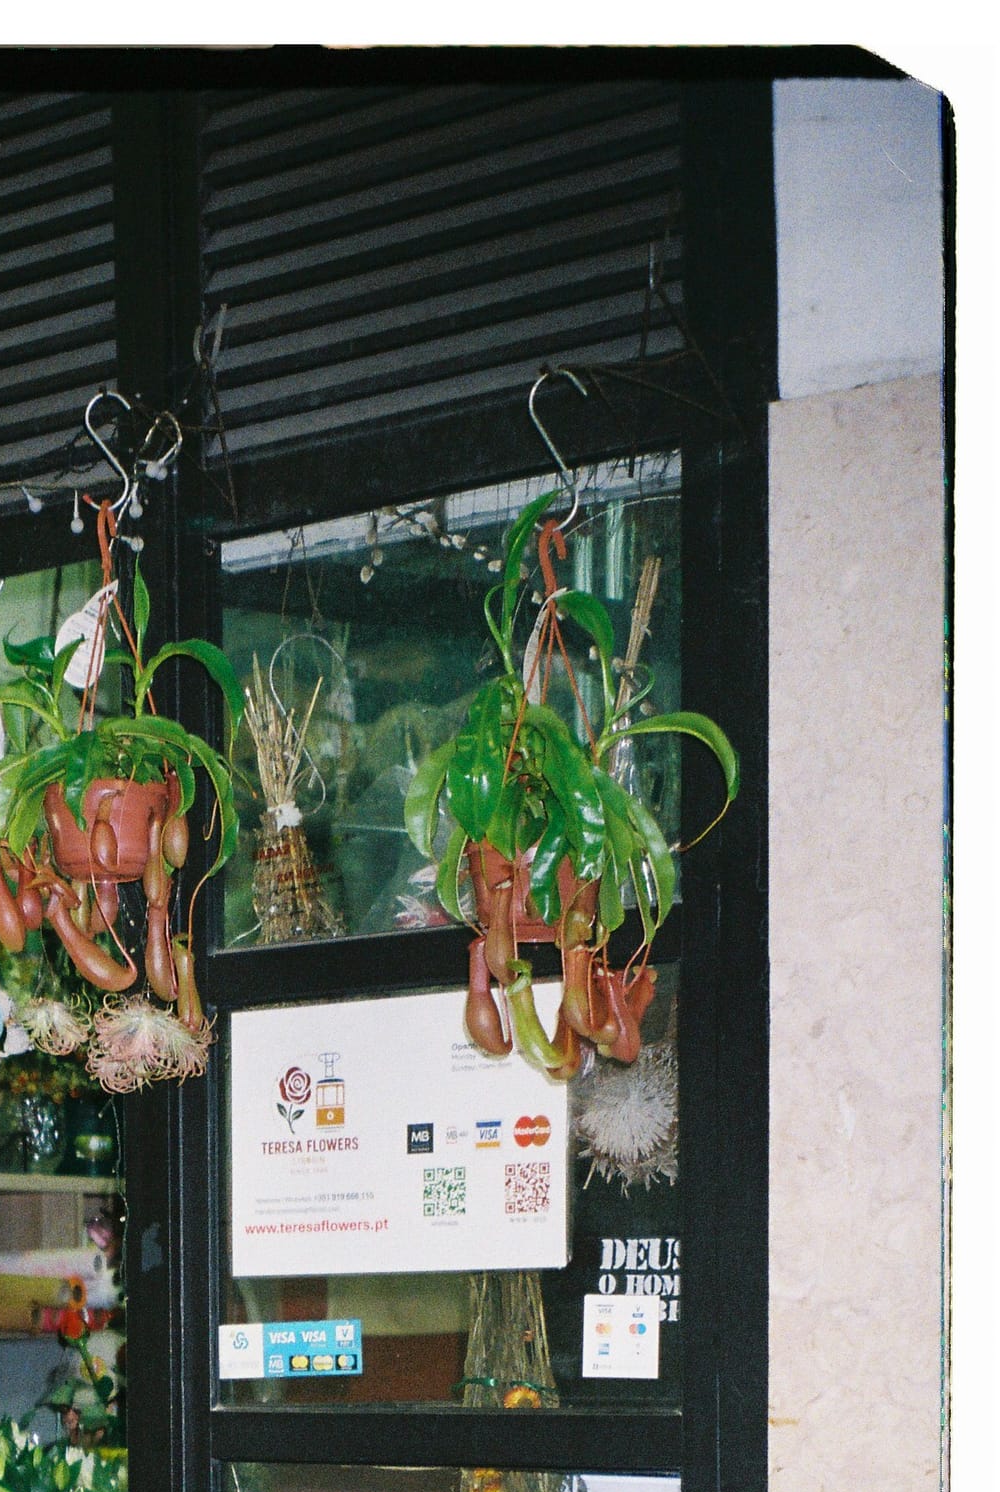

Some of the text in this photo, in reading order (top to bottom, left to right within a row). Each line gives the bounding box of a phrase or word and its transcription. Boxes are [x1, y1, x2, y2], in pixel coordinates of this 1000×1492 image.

[411, 1130, 430, 1143] MB
[479, 1128, 498, 1140] VISA
[262, 1137, 359, 1155] TERESA FLOWERS
[245, 1218, 389, 1235] www.teresaflowers.pt
[598, 1274, 616, 1295] O
[268, 1331, 296, 1344] VISA
[302, 1330, 326, 1343] VISA
